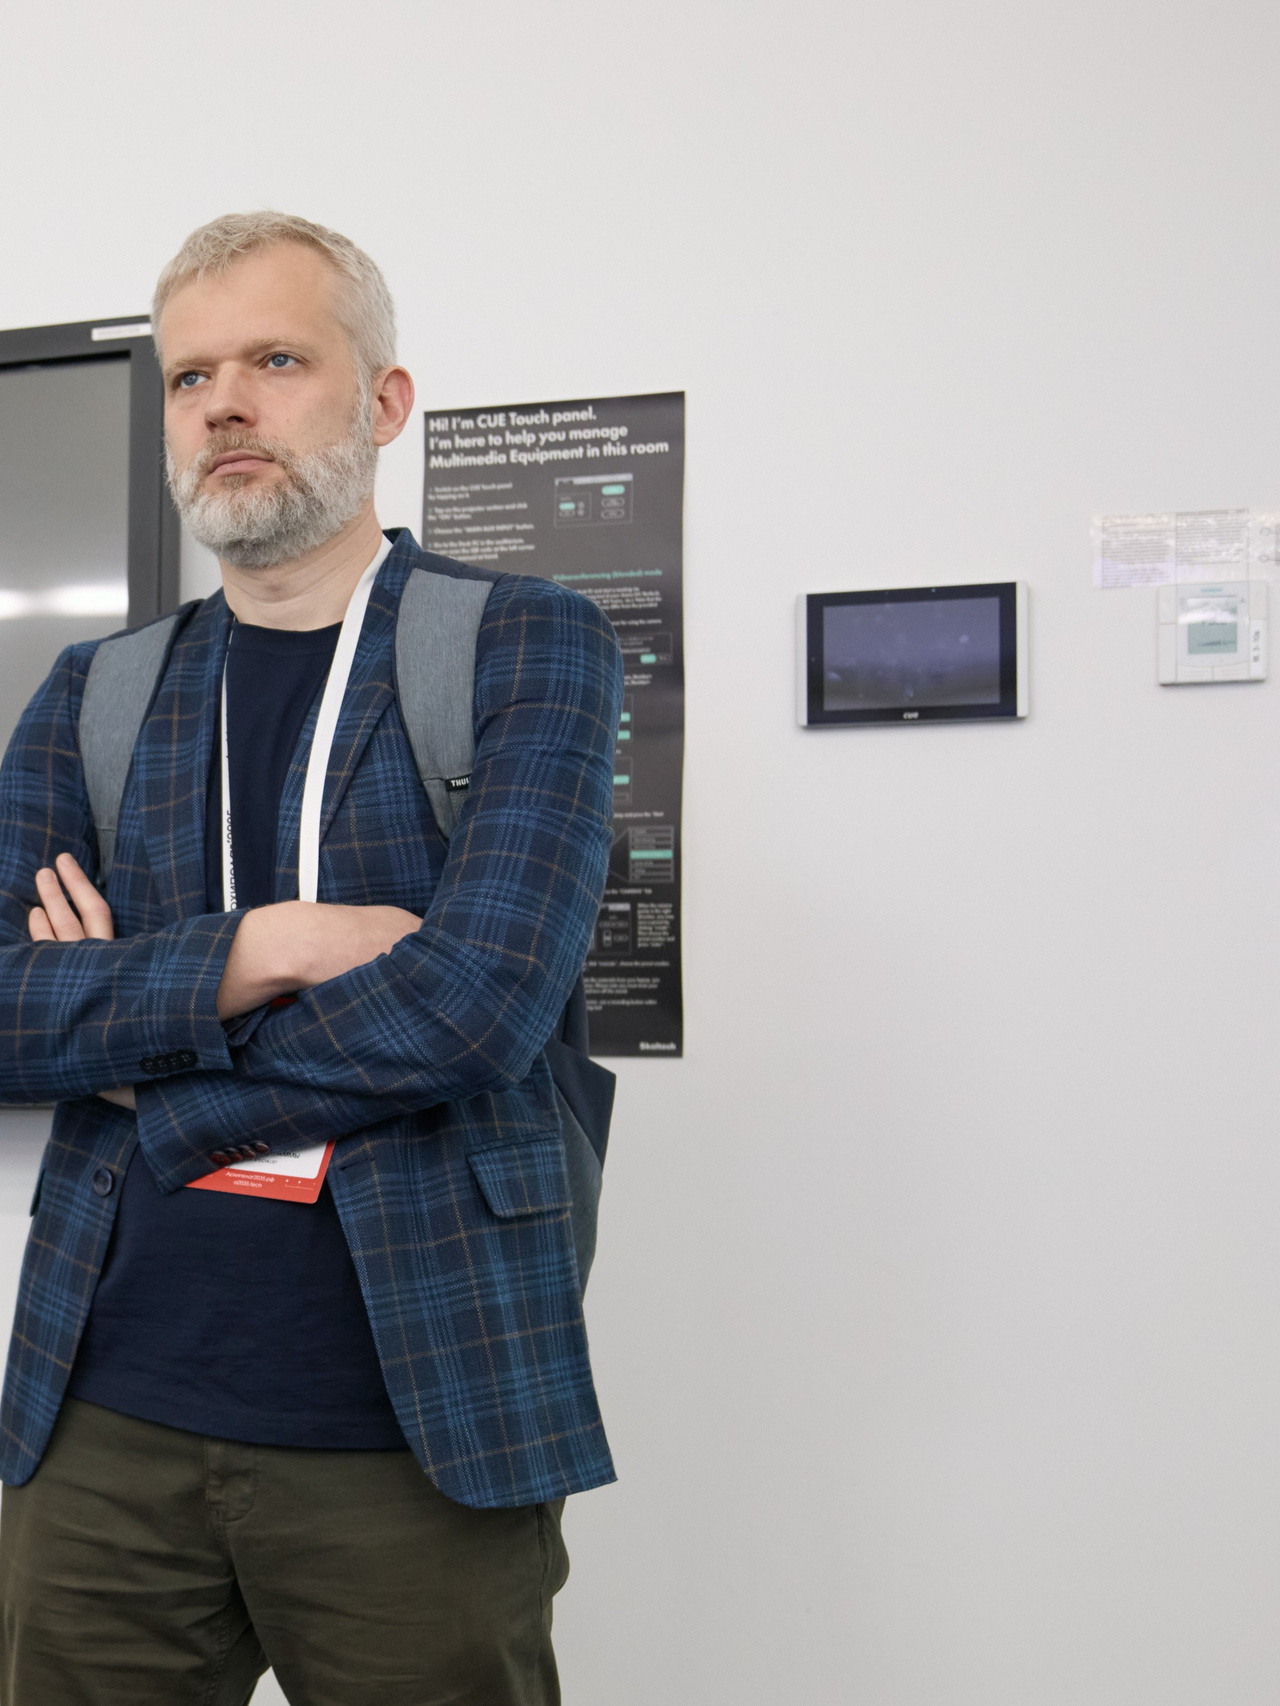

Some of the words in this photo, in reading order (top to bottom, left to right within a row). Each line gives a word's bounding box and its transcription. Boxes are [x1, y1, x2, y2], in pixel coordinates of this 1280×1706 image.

[429, 417, 449, 432] Hi!
[451, 416, 475, 431] I'm
[476, 413, 507, 429] CUE
[508, 408, 550, 426] Touch
[552, 404, 597, 426] panel.
[429, 436, 452, 451] I'm
[454, 433, 486, 449] here
[487, 433, 503, 447] to
[504, 429, 536, 447] help
[538, 430, 566, 447] you
[568, 426, 628, 441] manage
[429, 449, 507, 469] Multimedia
[509, 445, 584, 466] Equipment
[586, 442, 600, 458] in
[602, 441, 628, 457] this
[630, 441, 669, 454] room
